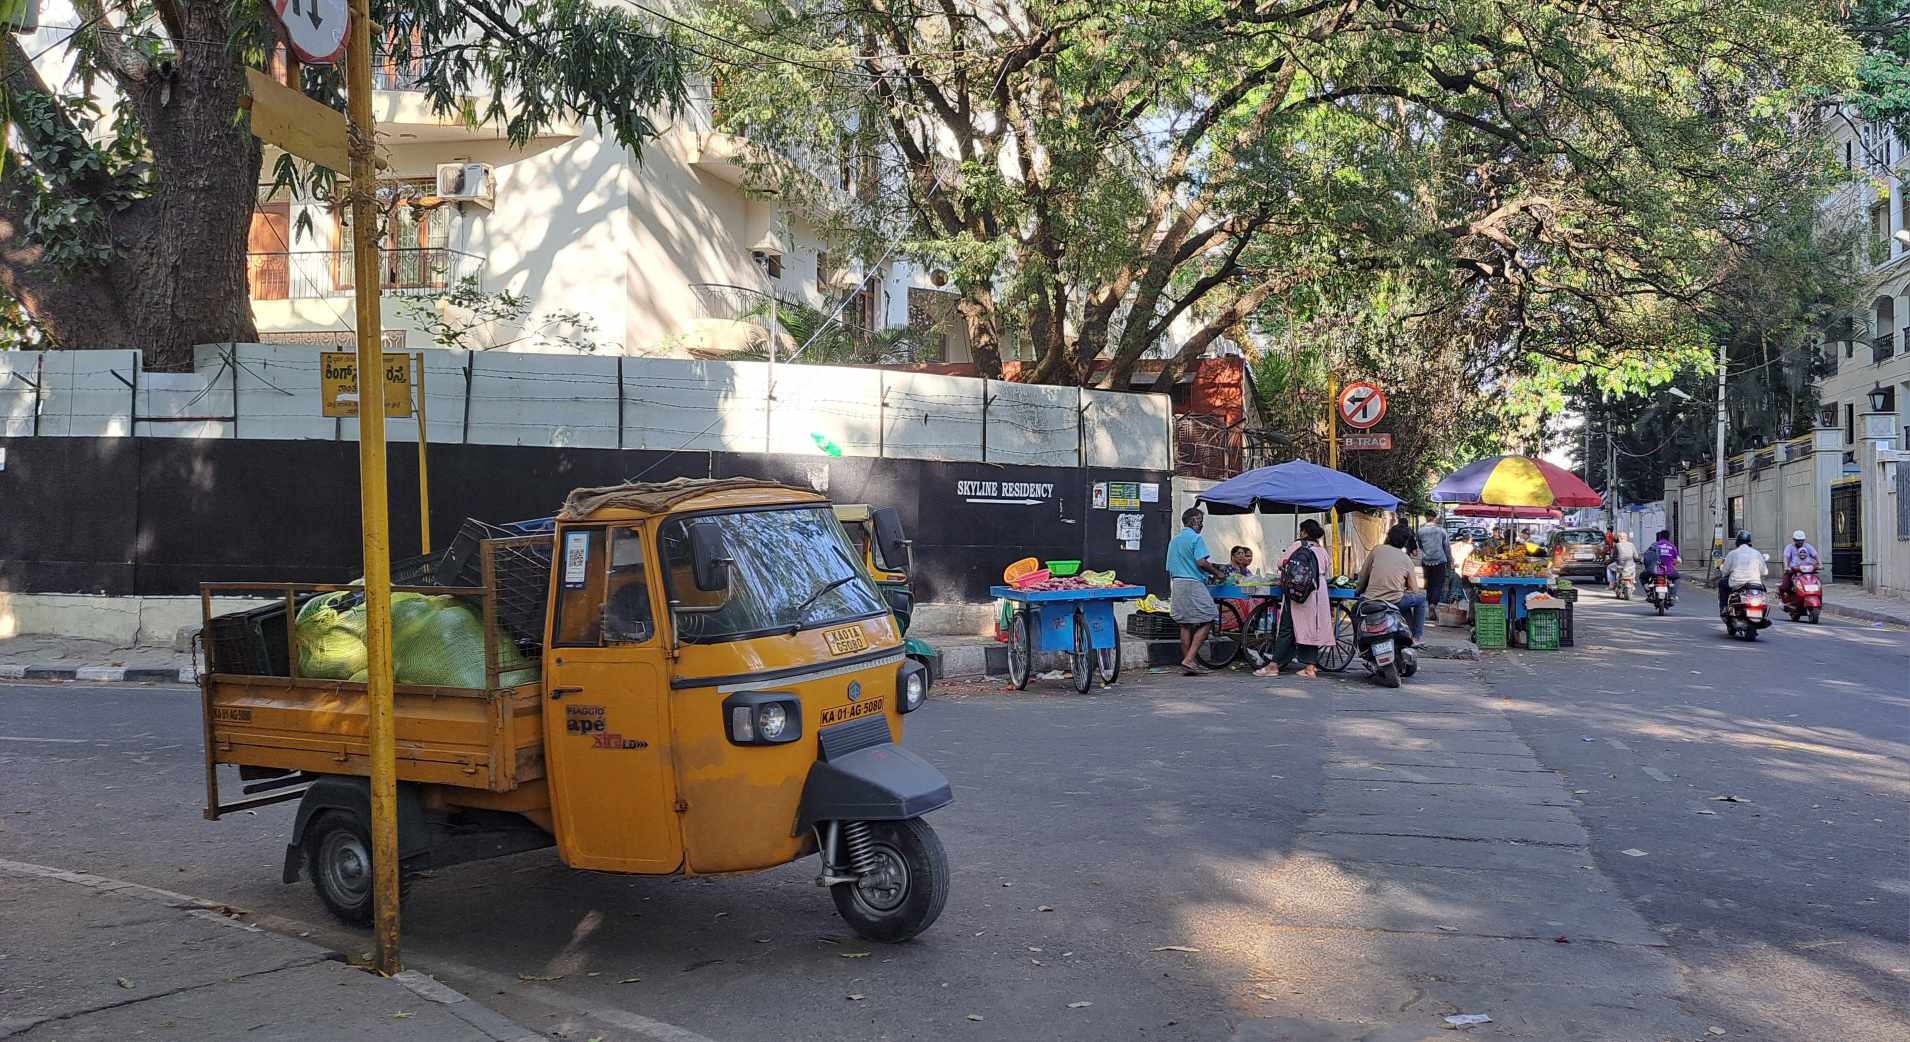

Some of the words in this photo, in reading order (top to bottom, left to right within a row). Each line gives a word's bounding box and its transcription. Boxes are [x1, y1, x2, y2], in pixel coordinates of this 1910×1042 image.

[957, 480, 998, 497] SKYLINE
[1001, 482, 1054, 498] RESIDENCY
[822, 711, 835, 724] KA
